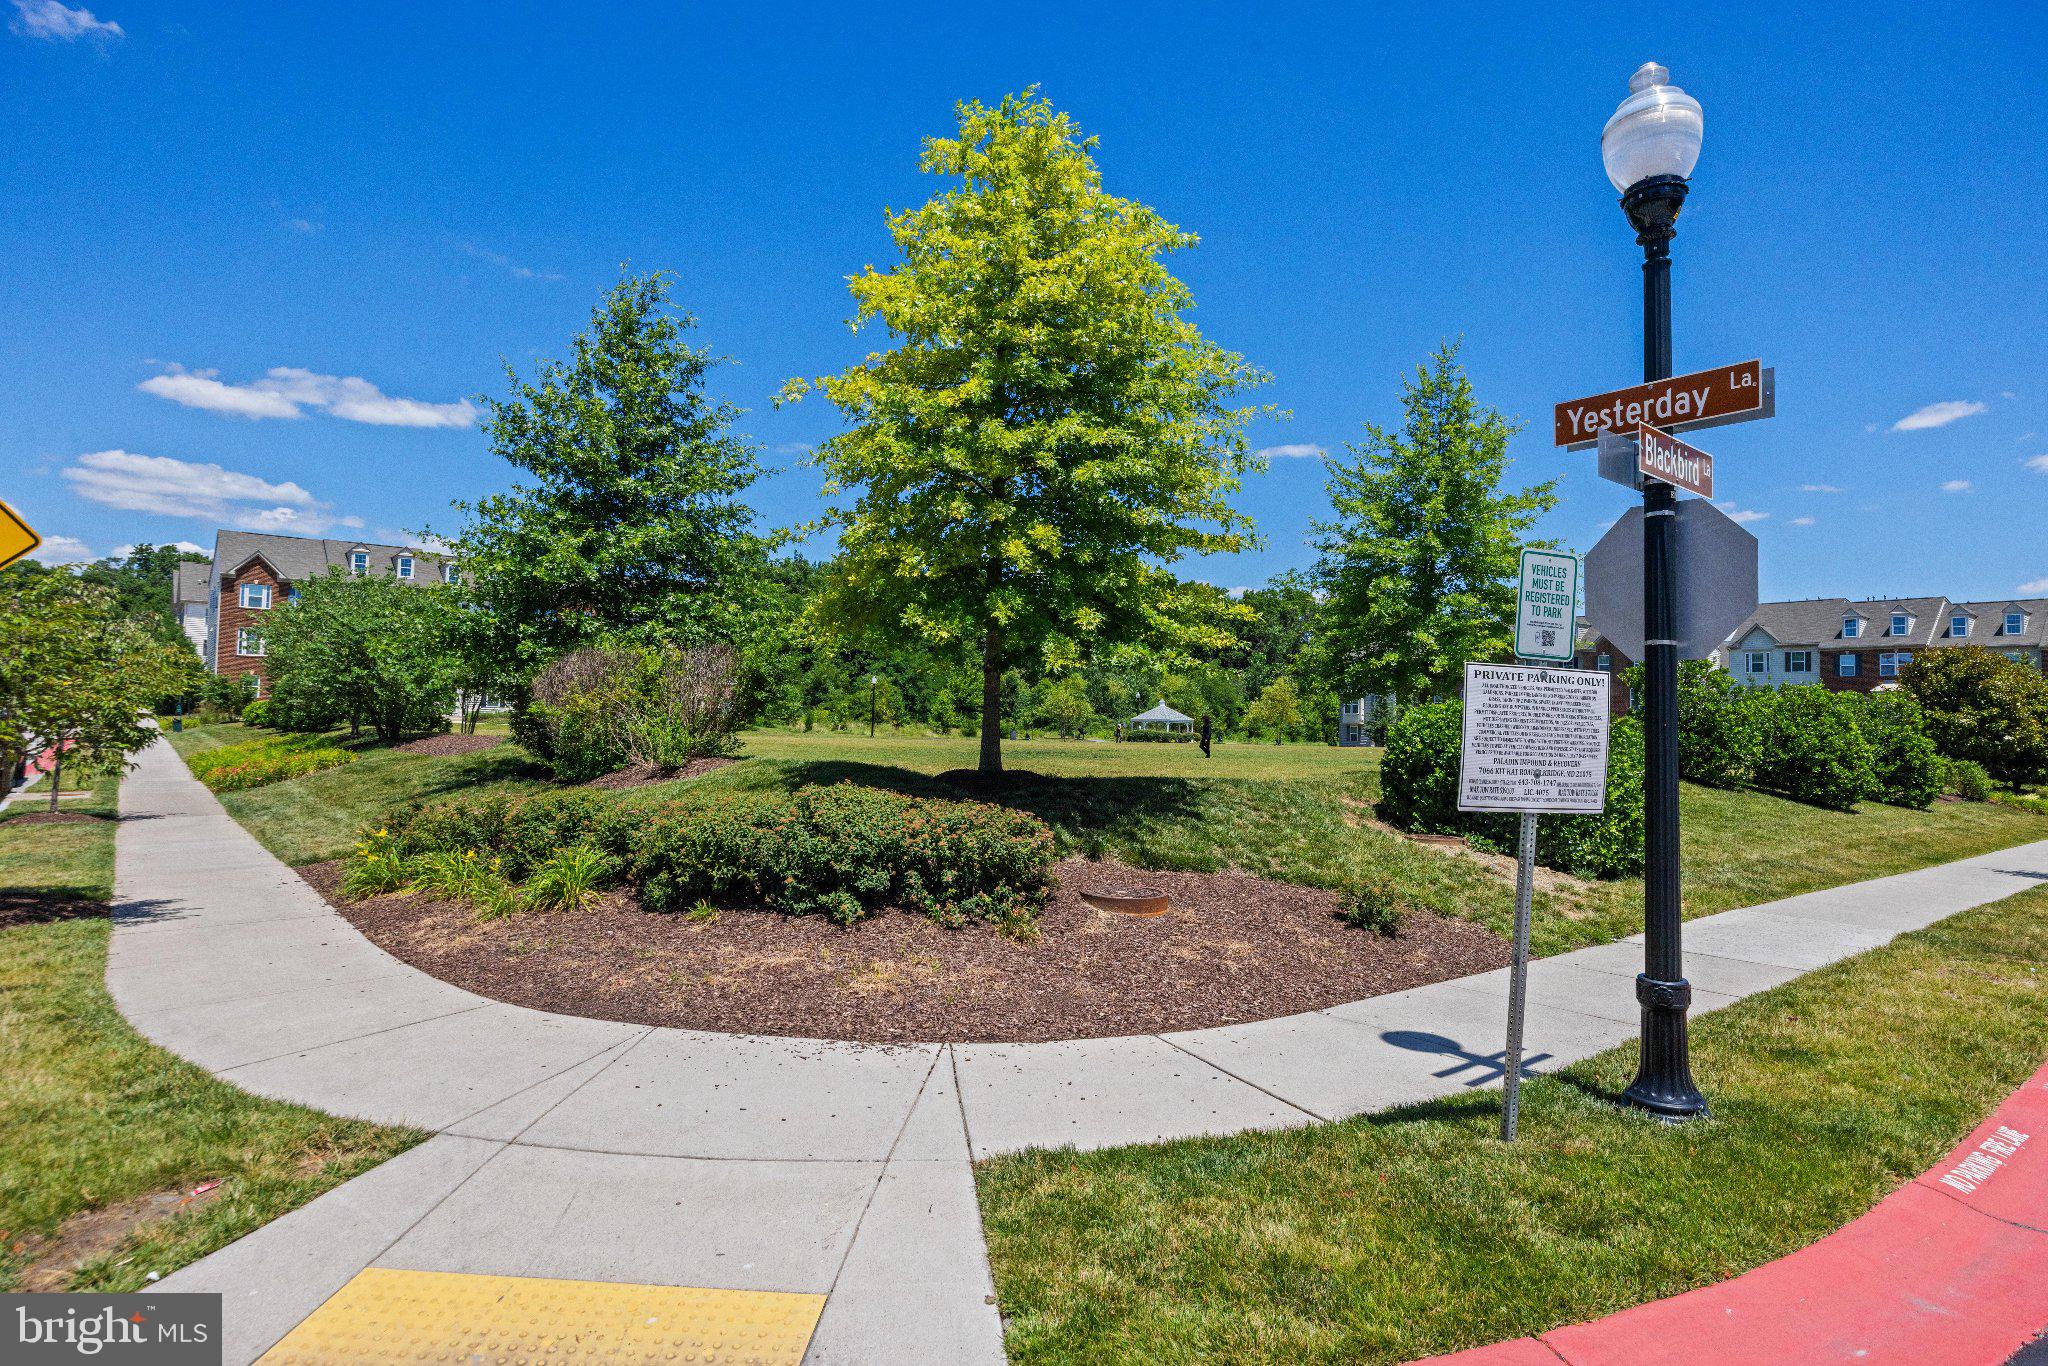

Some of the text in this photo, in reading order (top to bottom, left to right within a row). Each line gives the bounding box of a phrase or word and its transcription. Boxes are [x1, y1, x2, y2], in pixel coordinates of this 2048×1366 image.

[1566, 371, 1757, 436] Yesterday La.
[1645, 432, 1701, 486] Blackbird
[1531, 563, 1567, 579] VEHICLES
[1532, 578, 1565, 592] MUST BE
[1525, 591, 1570, 606] REGISTERED
[1531, 605, 1563, 619] TO PARK
[1474, 669, 1524, 682] PRIVATE
[1577, 676, 1605, 687] ONLY!
[1950, 1151, 2005, 1185] PARKING
[1938, 1174, 1977, 1195] NO
